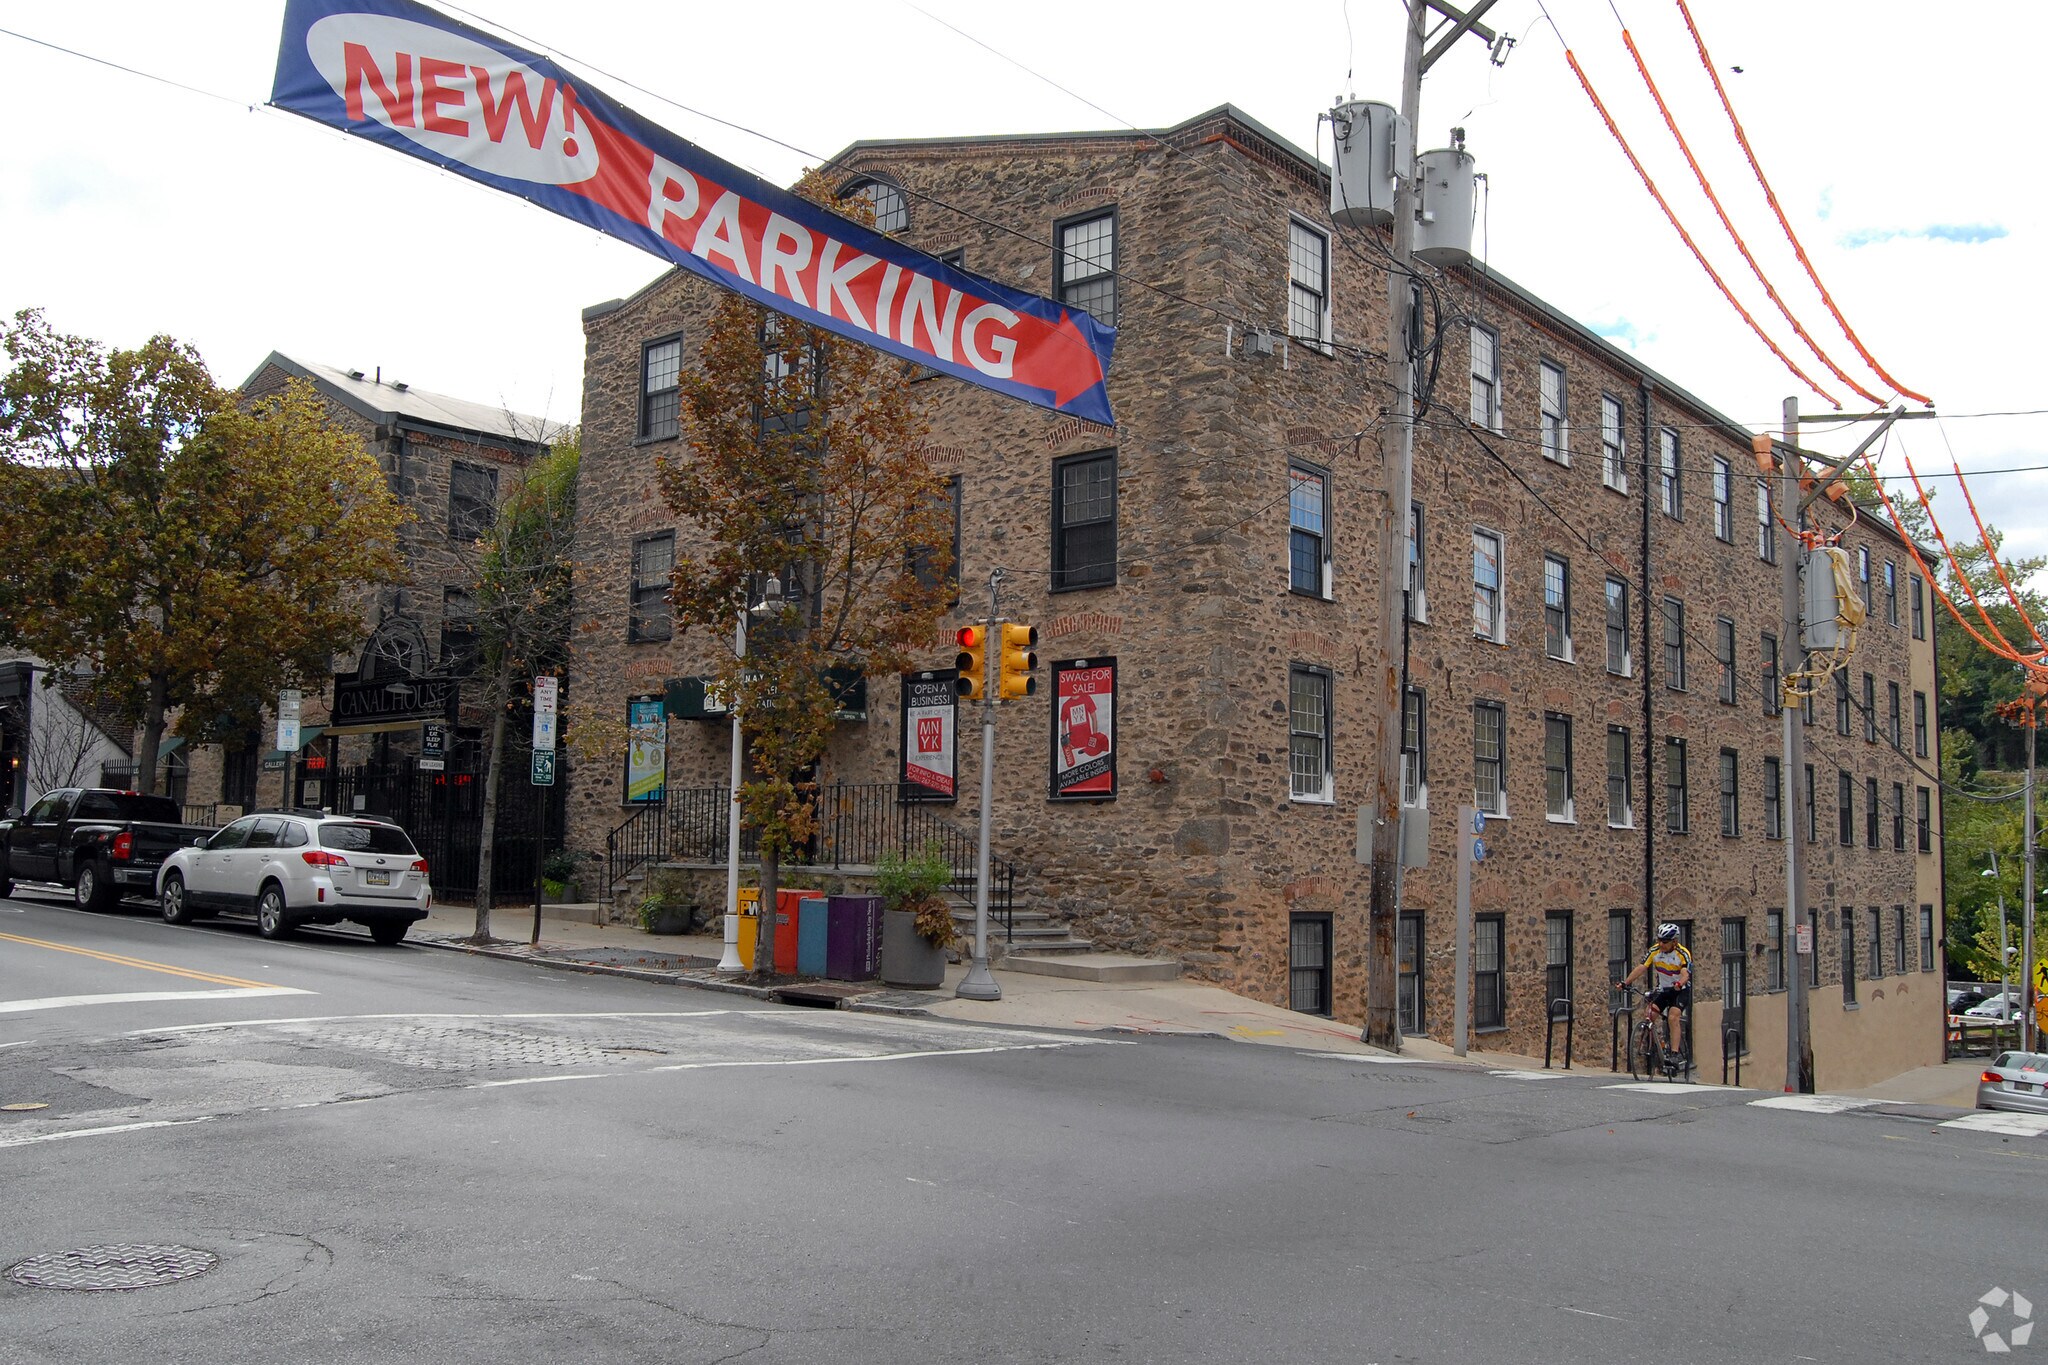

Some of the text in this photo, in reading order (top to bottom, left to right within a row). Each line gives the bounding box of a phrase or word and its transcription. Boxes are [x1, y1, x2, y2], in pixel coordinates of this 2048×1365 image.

[344, 41, 579, 157] NEW!
[647, 153, 1020, 379] PARKING
[1060, 669, 1111, 684] SWAG FOR
[281, 691, 287, 700] 2
[914, 683, 948, 695] OPEN A
[1072, 682, 1096, 694] SALE!
[339, 682, 447, 716] CANAL HOUSE
[911, 694, 950, 706] BUSINESS!
[920, 720, 939, 735] MN
[921, 735, 939, 750] YK
[1061, 759, 1105, 781] MORE COLORS
[1059, 772, 1090, 789] AVAILABLE
[740, 900, 758, 916] PW
